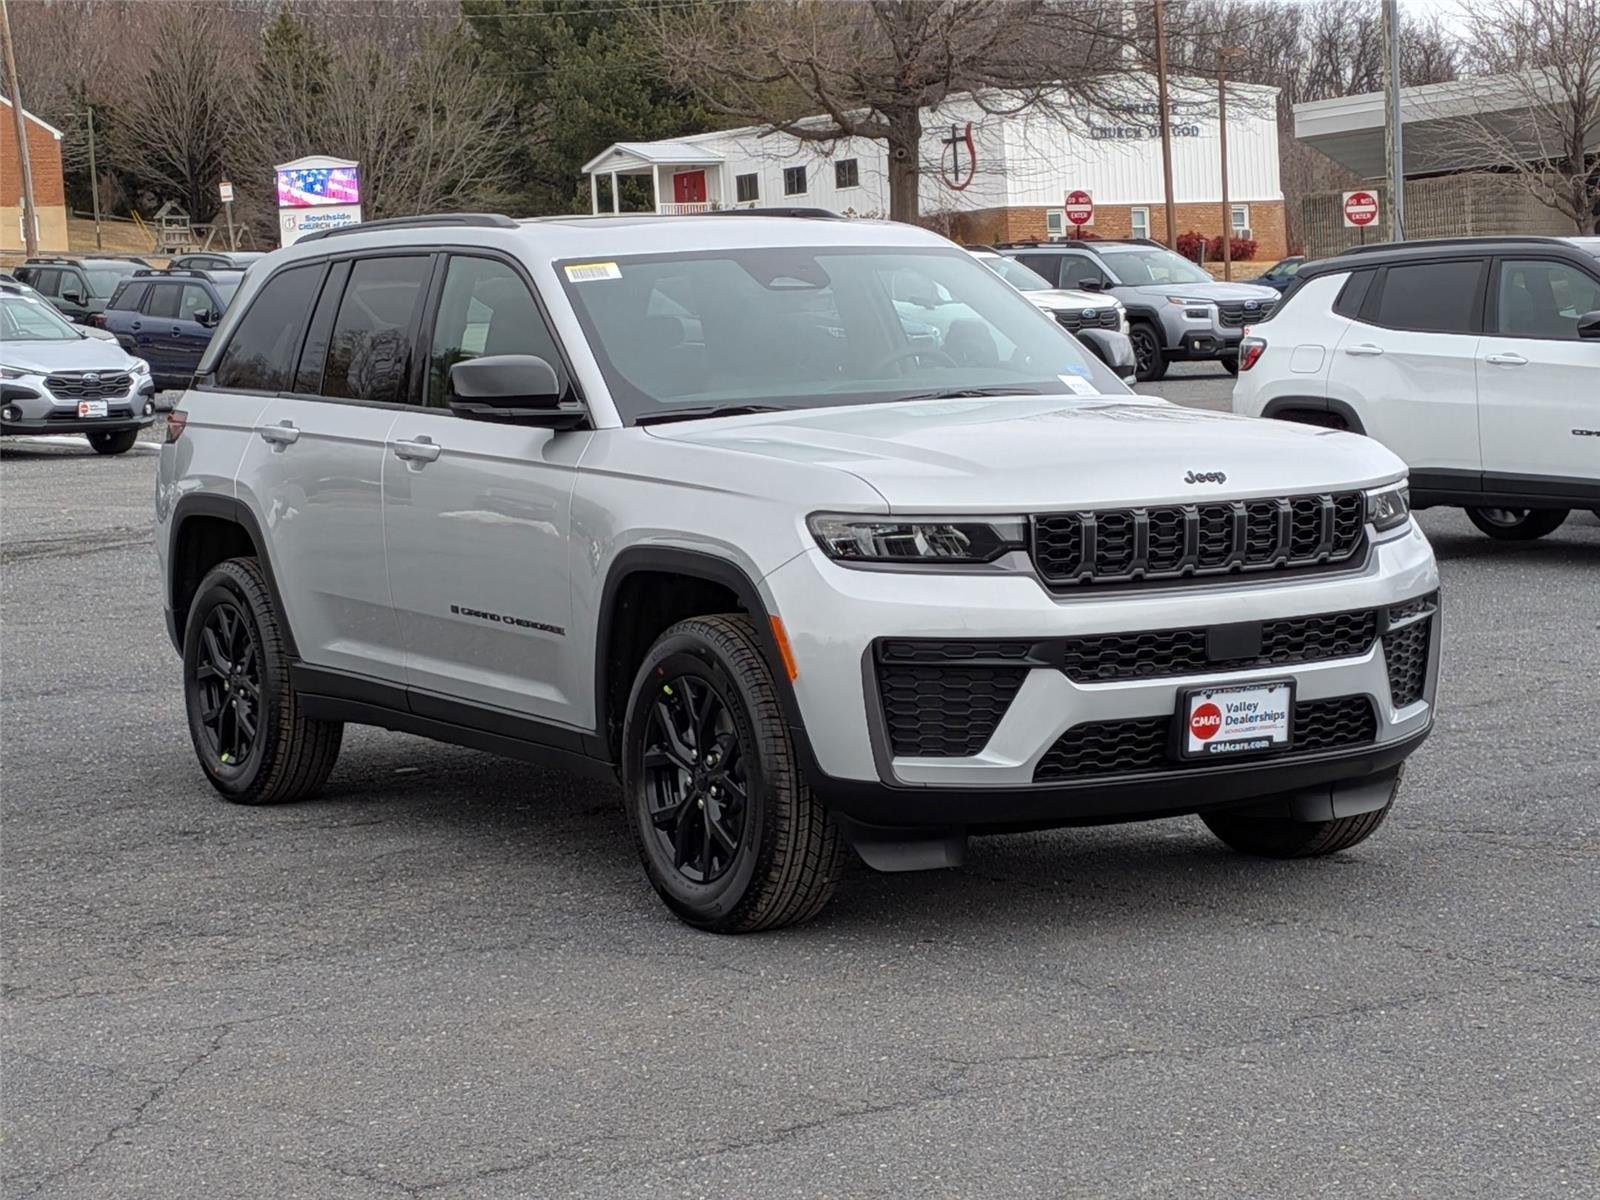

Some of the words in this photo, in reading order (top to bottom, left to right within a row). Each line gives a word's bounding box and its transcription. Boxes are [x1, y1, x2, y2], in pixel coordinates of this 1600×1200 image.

[1172, 125, 1199, 137] GOD
[304, 212, 352, 222] Southside
[1352, 212, 1372, 220] ENTER
[298, 221, 331, 231] CHURCH
[1183, 470, 1227, 485] Jeep
[461, 607, 501, 622] GRAND
[502, 616, 566, 636] CHEROKEE
[1225, 702, 1259, 714] Valley
[1191, 714, 1220, 728] CMA's
[1225, 710, 1285, 726] Dealerships
[1209, 740, 1270, 753] CMAcars.com
